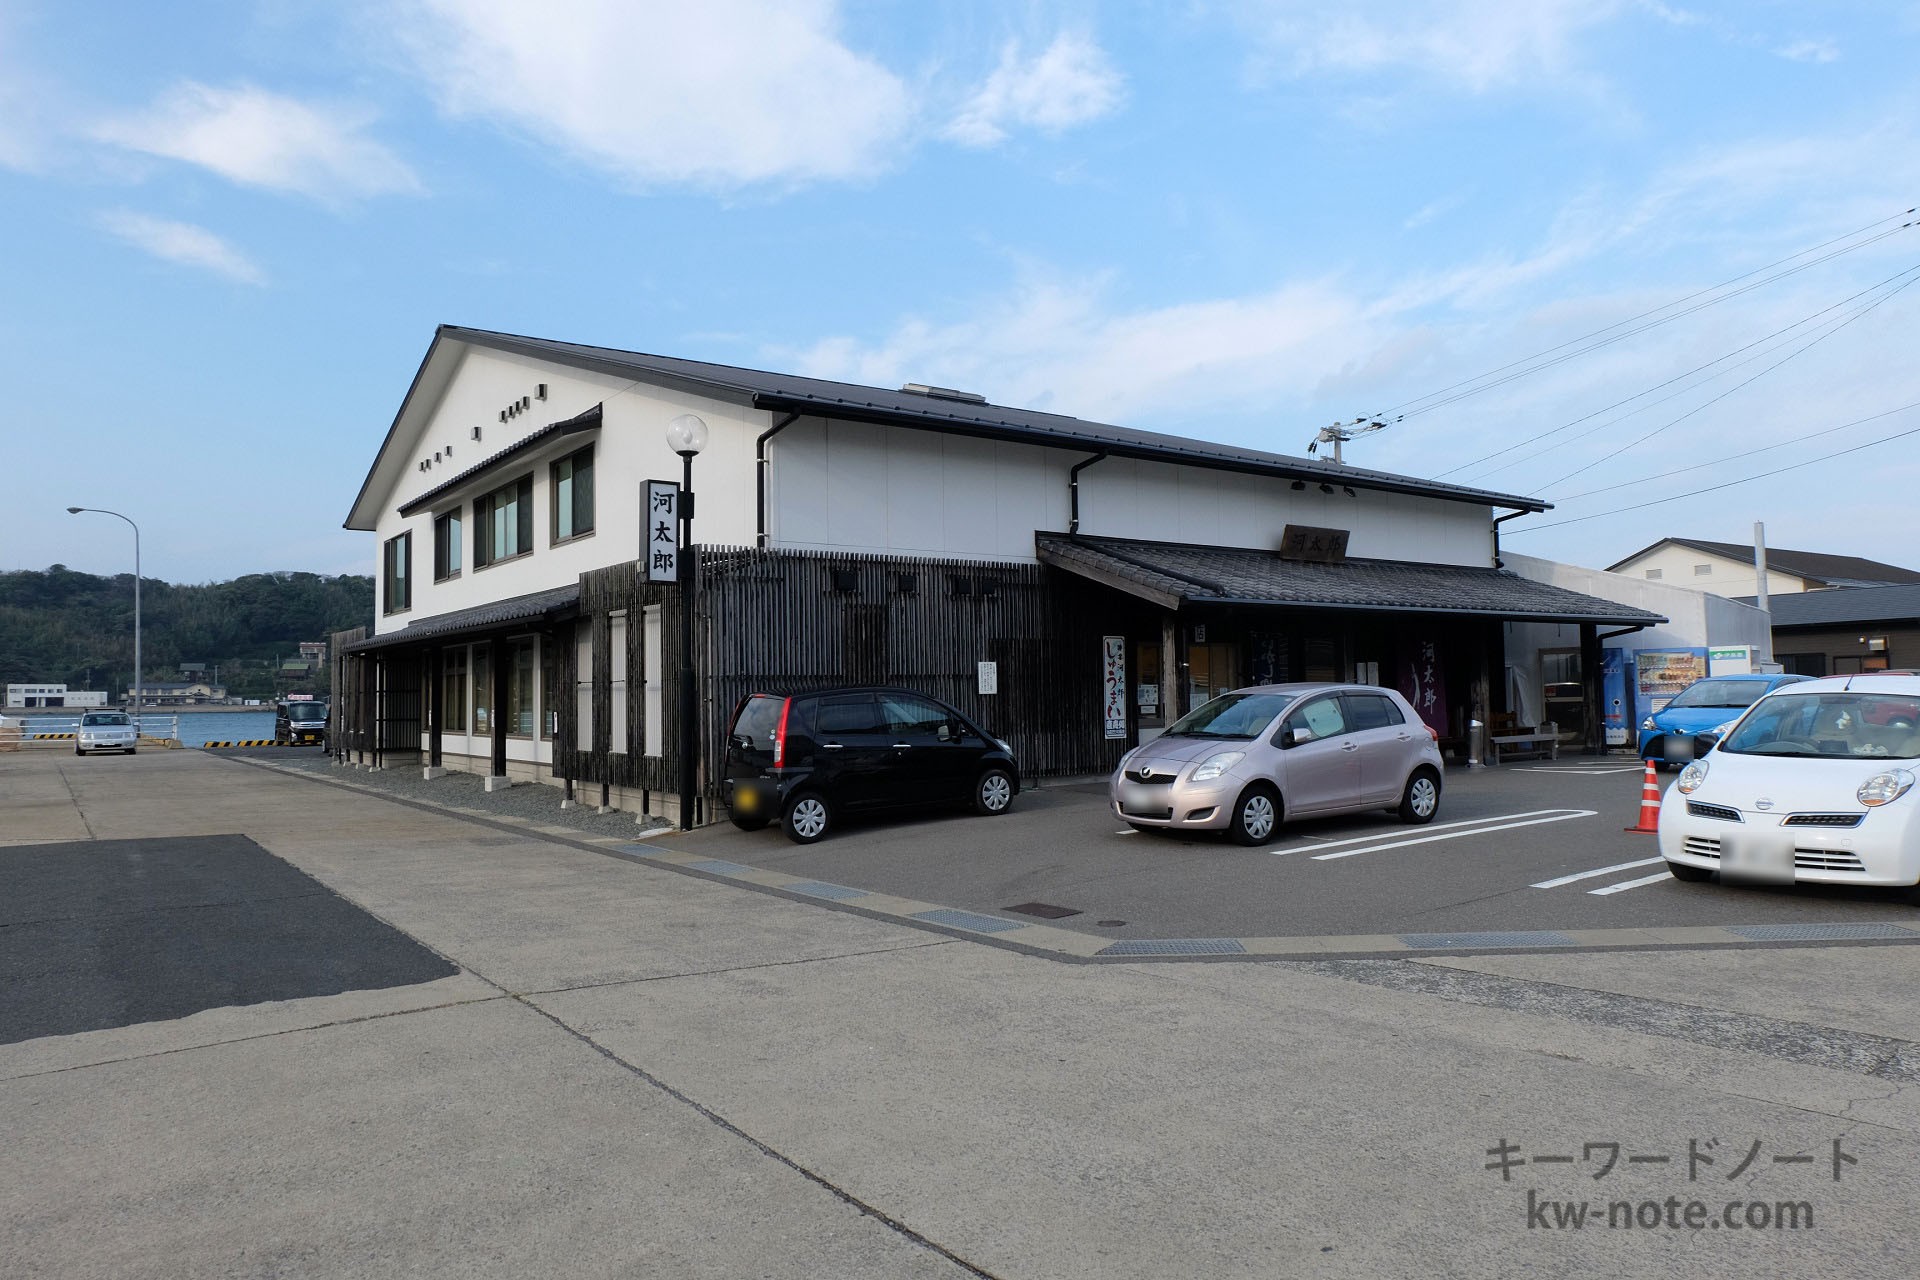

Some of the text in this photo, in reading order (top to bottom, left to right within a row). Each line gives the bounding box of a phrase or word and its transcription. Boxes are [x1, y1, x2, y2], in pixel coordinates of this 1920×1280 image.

[653, 491, 675, 574] 河太郎
[1291, 533, 1341, 555] 河太郎
[1106, 641, 1121, 719] しゅうまい
[1421, 641, 1437, 714] 河太郎
